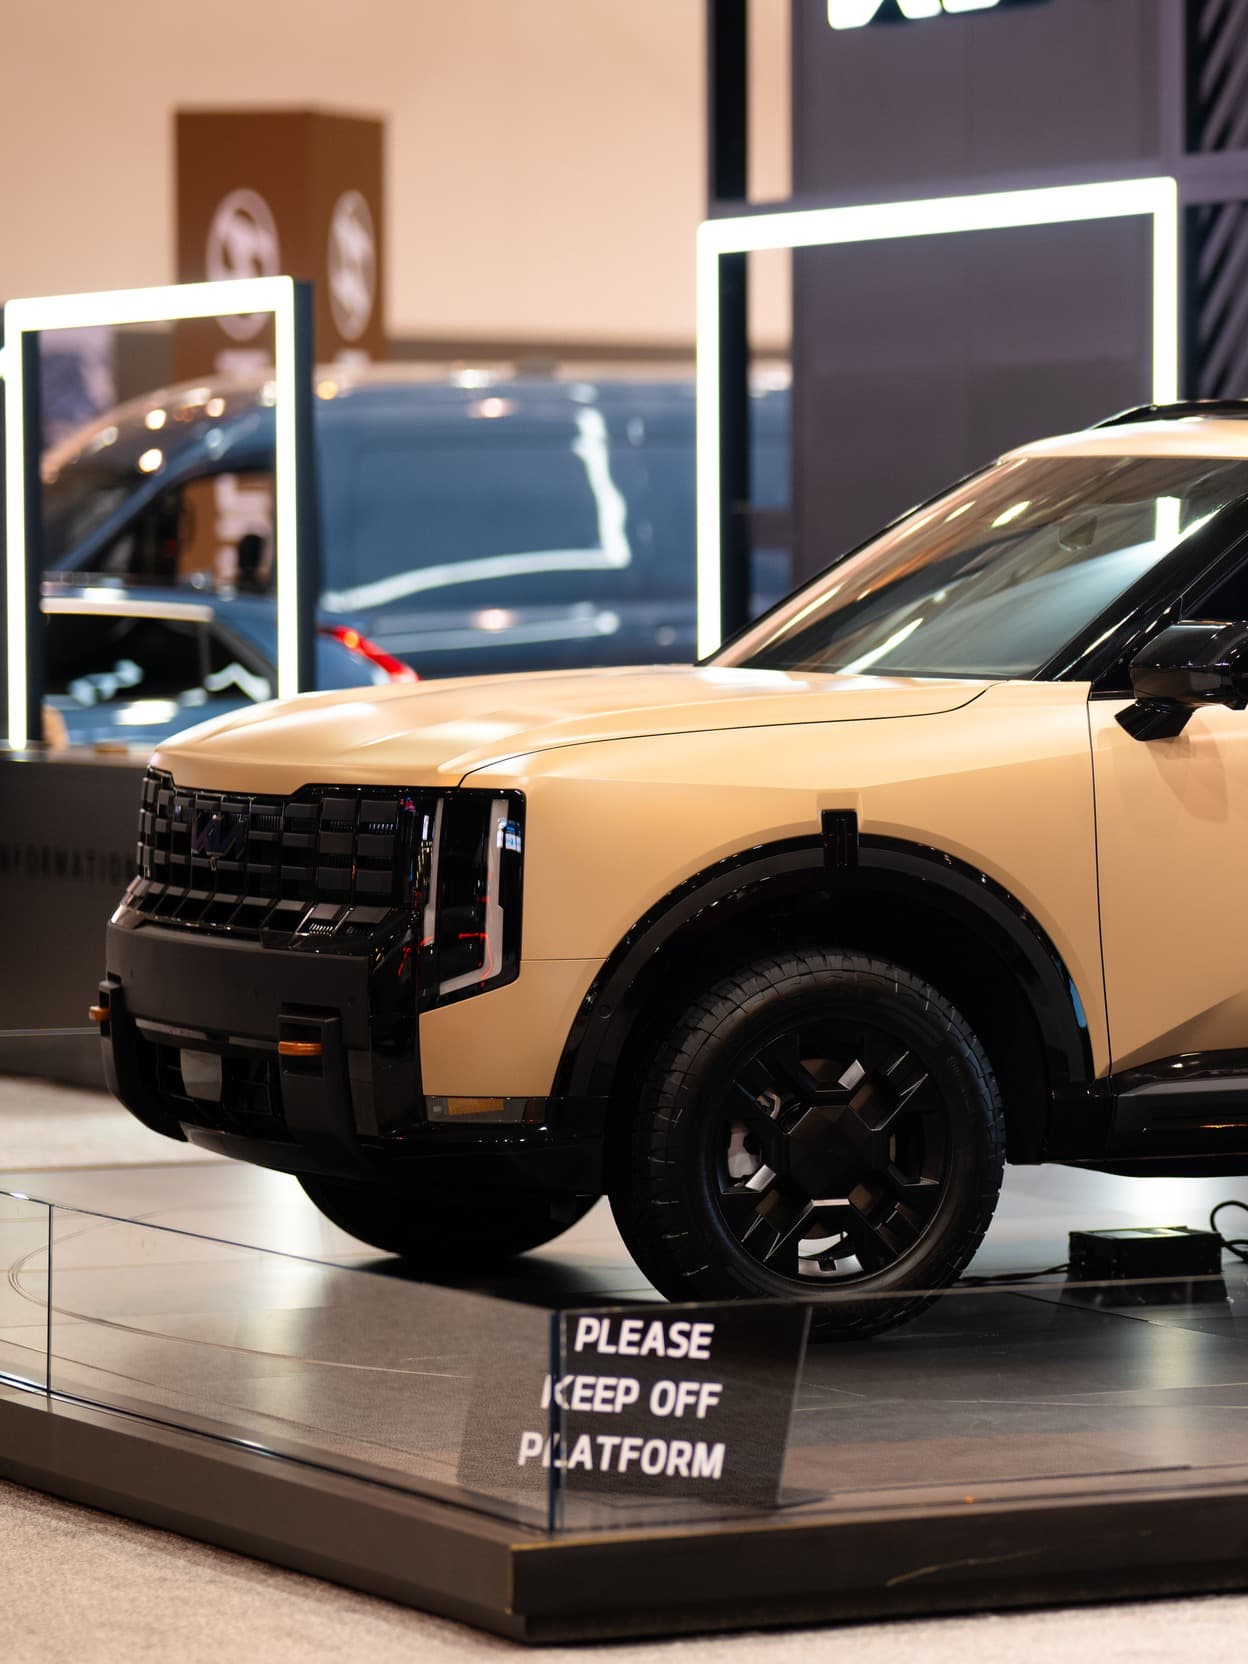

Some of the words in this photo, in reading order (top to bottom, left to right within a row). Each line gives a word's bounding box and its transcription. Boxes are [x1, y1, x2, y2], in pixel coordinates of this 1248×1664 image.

[574, 1317, 715, 1360] PLEASE
[541, 1375, 640, 1413] KEEP
[649, 1381, 723, 1419] OFF
[518, 1432, 725, 1480] PLATFORM
